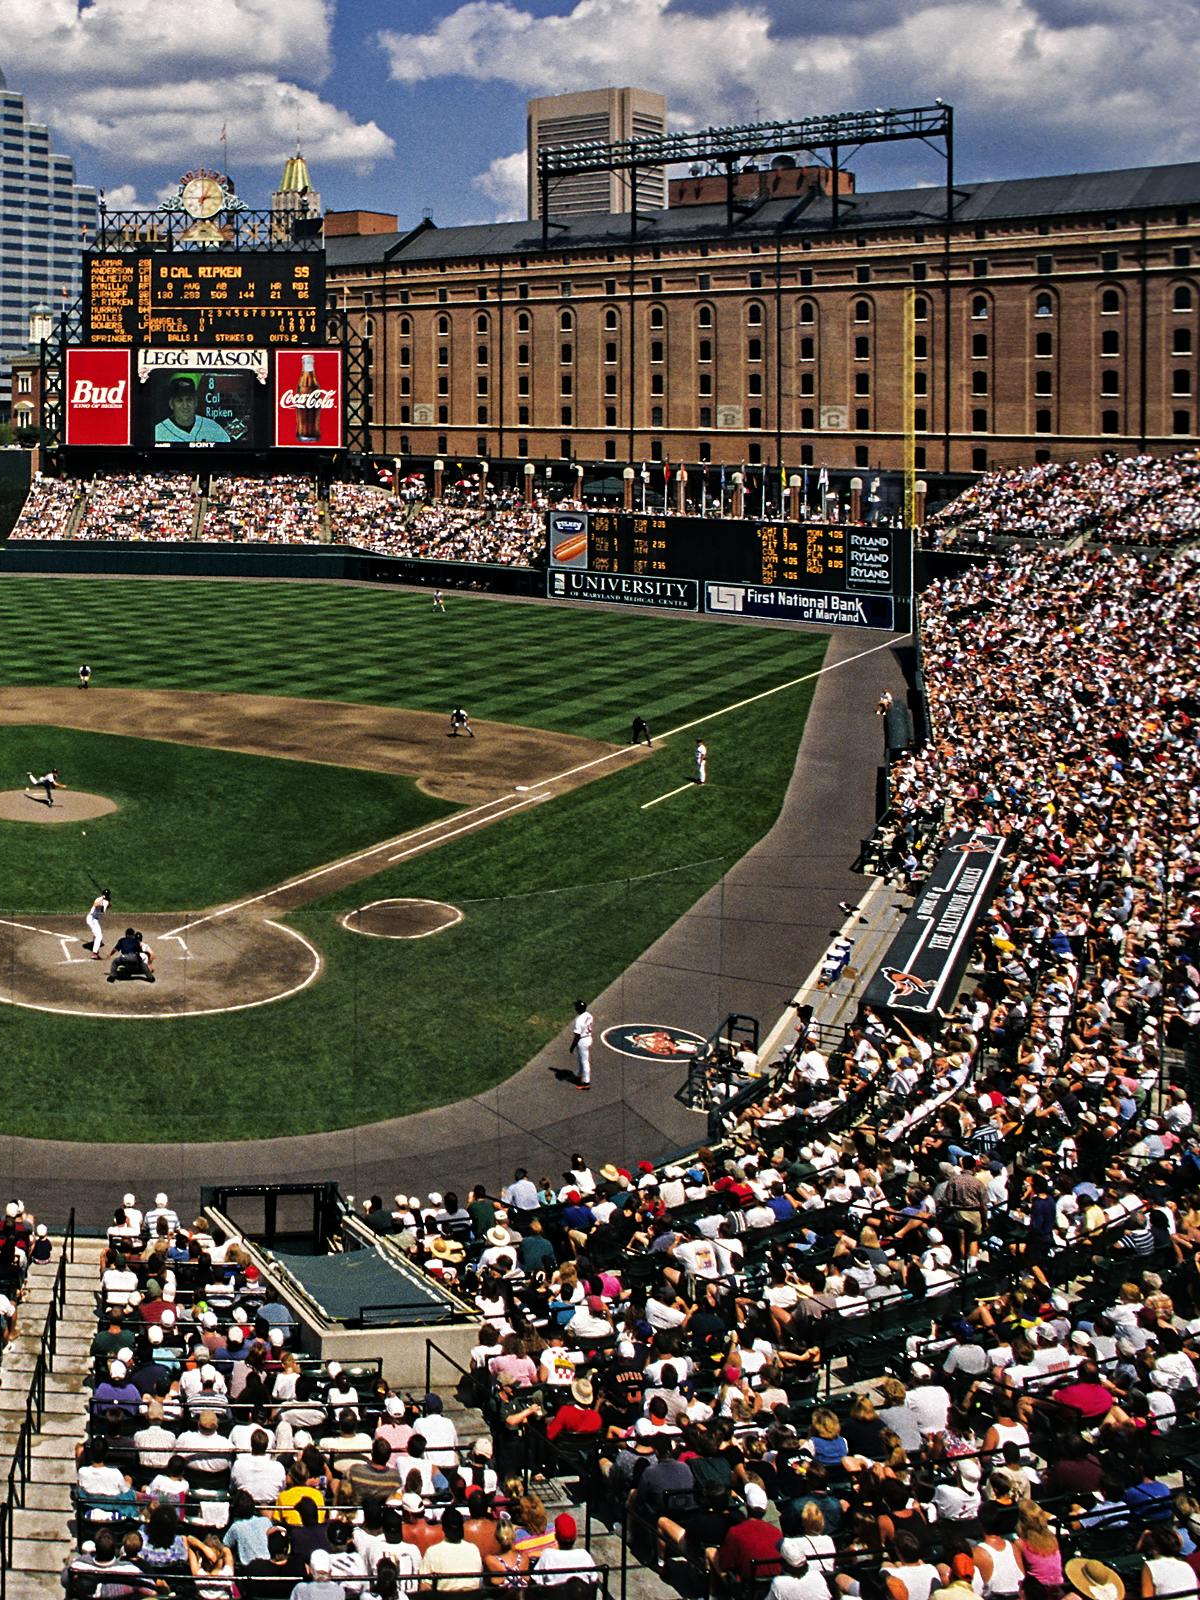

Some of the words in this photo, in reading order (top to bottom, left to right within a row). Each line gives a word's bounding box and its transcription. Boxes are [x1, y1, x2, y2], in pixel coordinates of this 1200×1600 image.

[160, 267, 168, 278] 8
[171, 267, 192, 278] CAL
[198, 267, 242, 278] RIPKEN
[294, 266, 310, 278] SS
[291, 334, 298, 342] 2
[144, 350, 189, 366] LEGG
[196, 350, 263, 366] MASON
[208, 378, 215, 390] 8
[71, 380, 126, 404] Bud
[206, 393, 220, 403] Cal
[206, 406, 233, 419] Ripken
[850, 535, 889, 546] RYLAND
[850, 551, 889, 562] RYLAND
[850, 567, 889, 578] RYLAND
[572, 574, 688, 598] UNIVERSITY
[582, 592, 621, 601] MARYLAND
[624, 596, 655, 604] MEDICAL
[658, 598, 688, 607] CENTER
[748, 589, 775, 604] First
[778, 592, 828, 609] National
[831, 596, 865, 616] Bank
[803, 608, 813, 618] of
[816, 609, 859, 623] Maryland
[936, 894, 972, 934] BALTIMORE
[928, 933, 953, 950] THE
